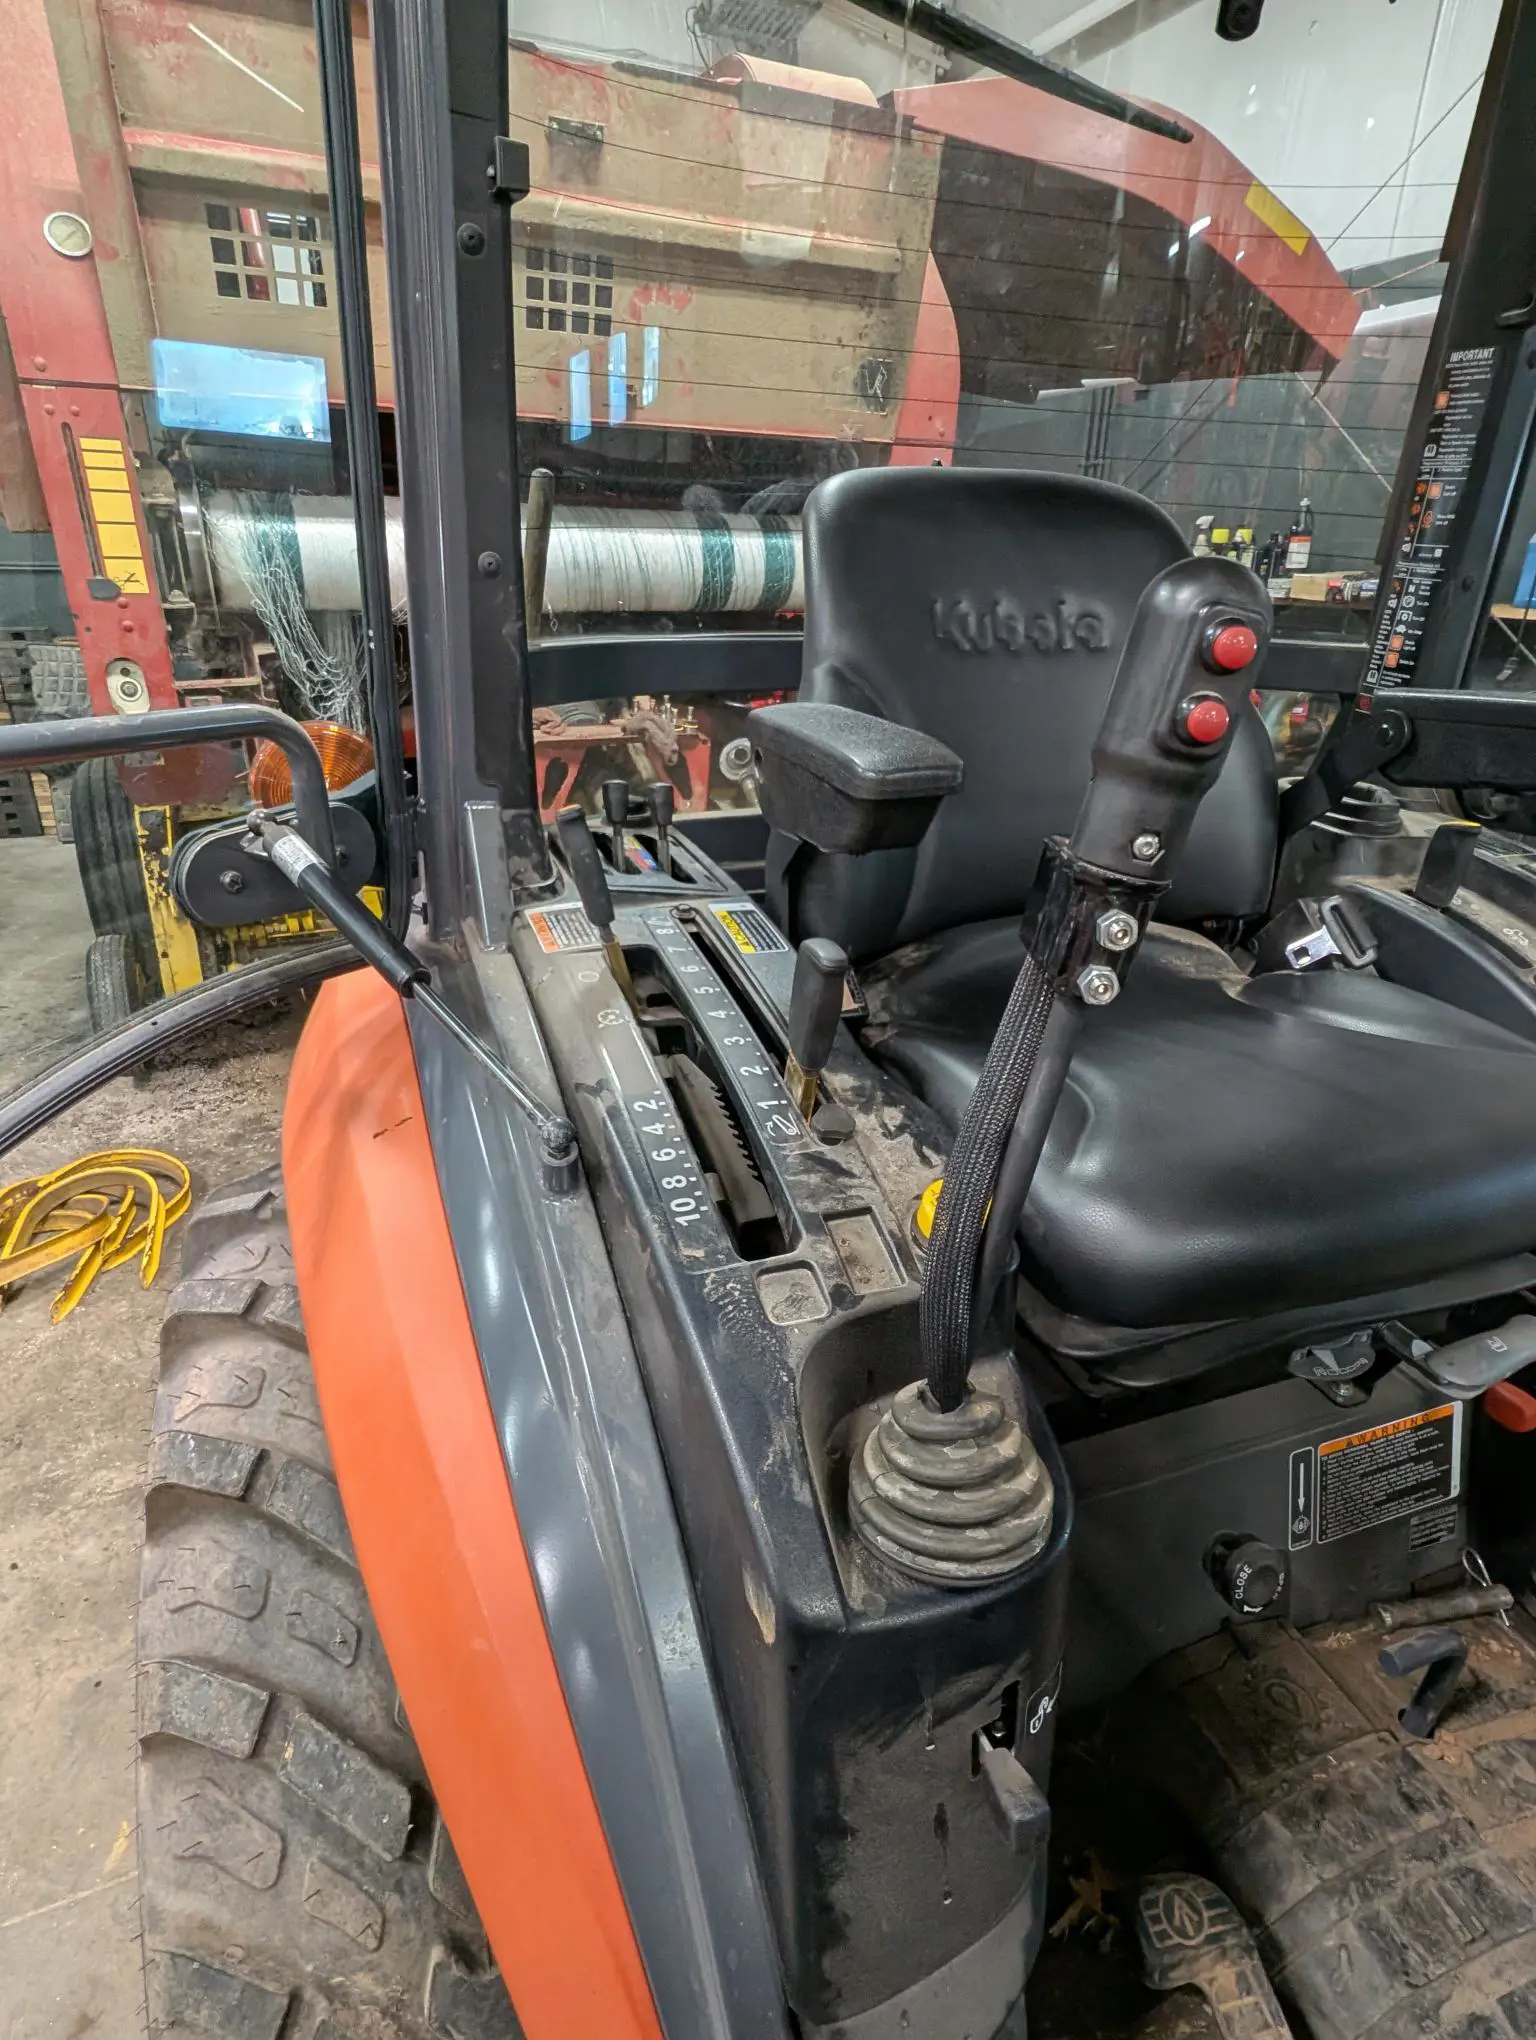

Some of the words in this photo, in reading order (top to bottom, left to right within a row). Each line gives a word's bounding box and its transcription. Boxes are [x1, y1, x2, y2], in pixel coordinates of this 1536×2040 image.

[1449, 347, 1495, 362] IMPORTANT
[931, 595, 1113, 652] Kubota
[680, 965, 700, 973] 6
[693, 986, 714, 994] 5
[707, 1010, 728, 1019] 4
[723, 1035, 745, 1046] 3
[740, 1064, 764, 1076] 2
[632, 1099, 658, 1112] 2
[757, 1100, 779, 1110] 1
[641, 1122, 666, 1135] 4
[651, 1148, 677, 1162] 6
[661, 1175, 687, 1190] 8
[670, 1197, 701, 1227] 10
[1357, 1413, 1432, 1443] WARNING
[1234, 1564, 1253, 1600] CLOSE
